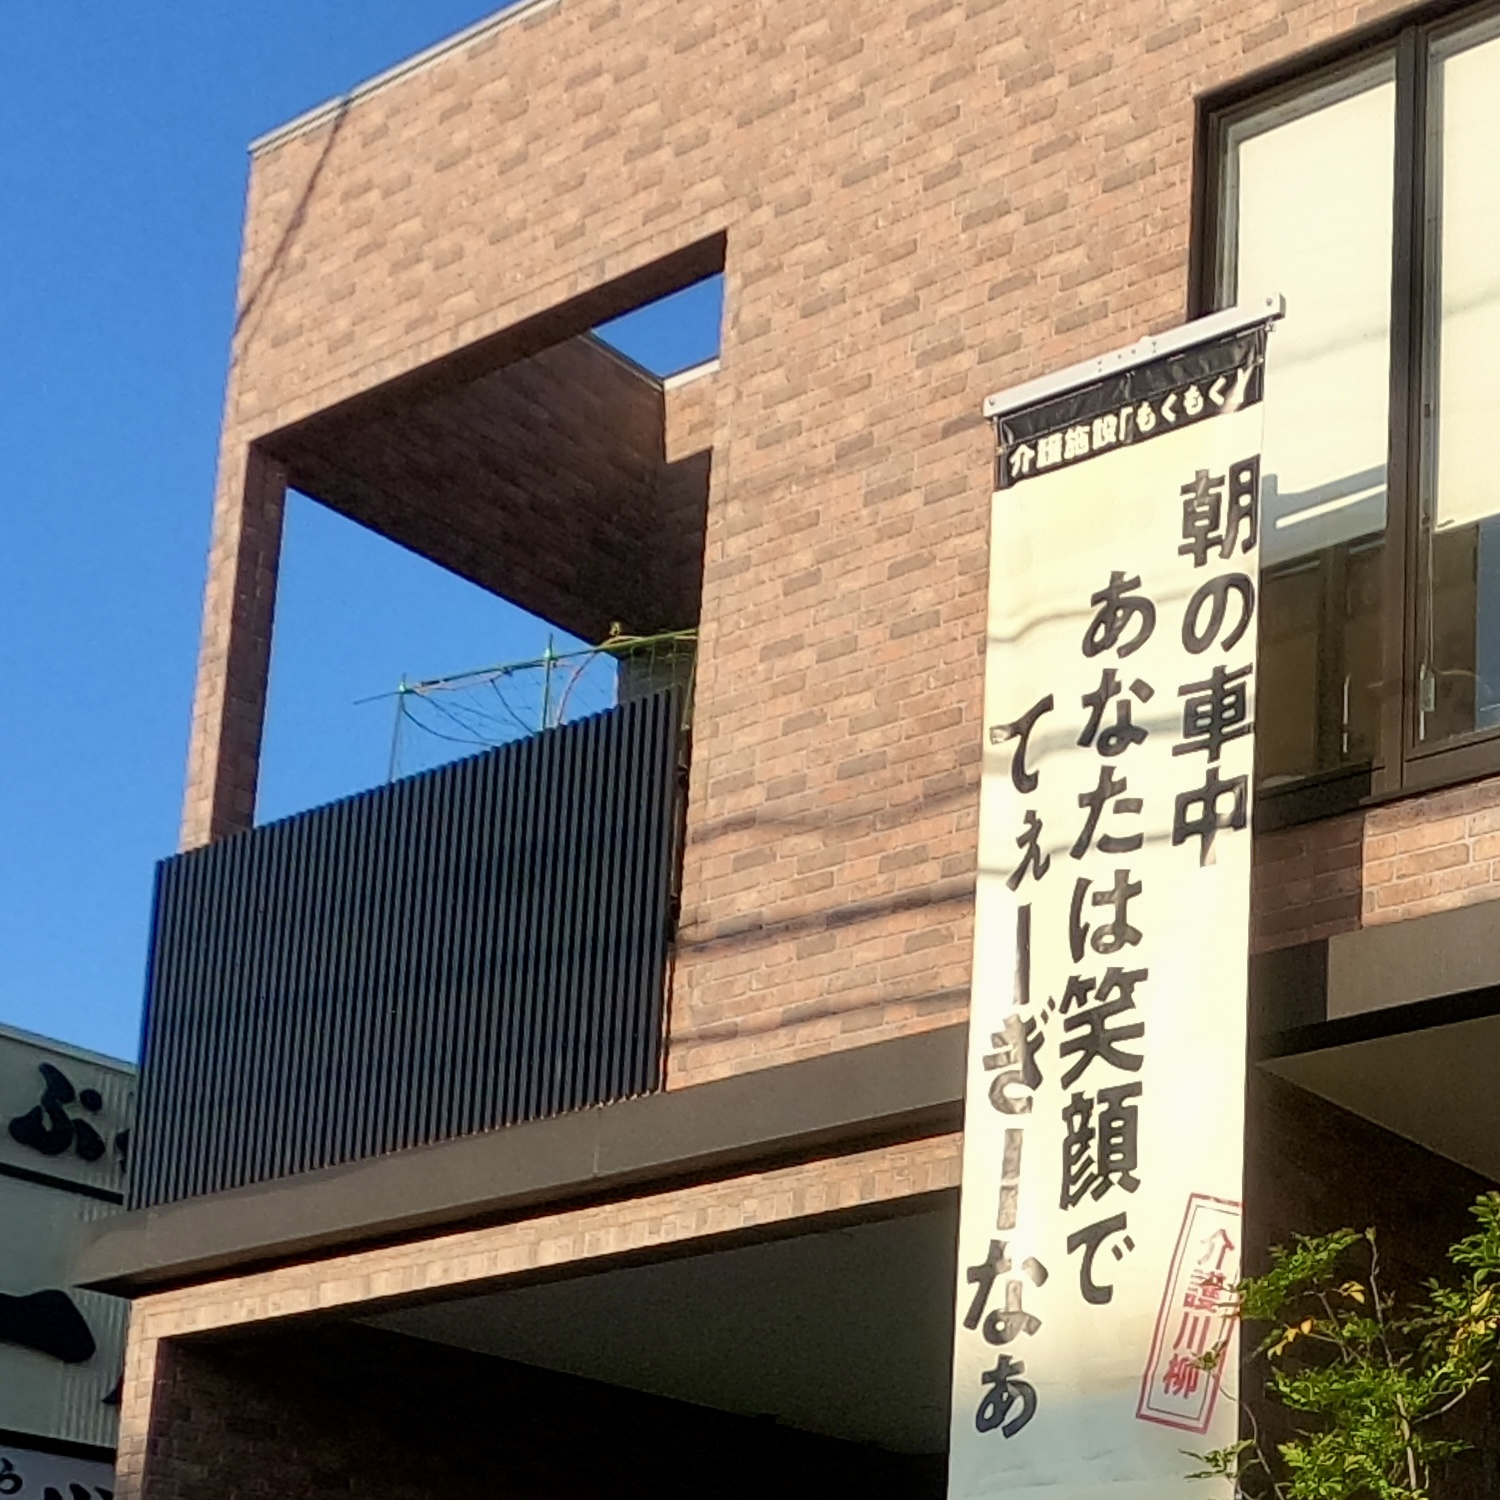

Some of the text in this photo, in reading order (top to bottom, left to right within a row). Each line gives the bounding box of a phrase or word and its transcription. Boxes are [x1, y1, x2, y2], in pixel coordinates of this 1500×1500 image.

[1058, 570, 1157, 1305] あなたは笑顔で
[1171, 452, 1261, 868] 朝の車中
